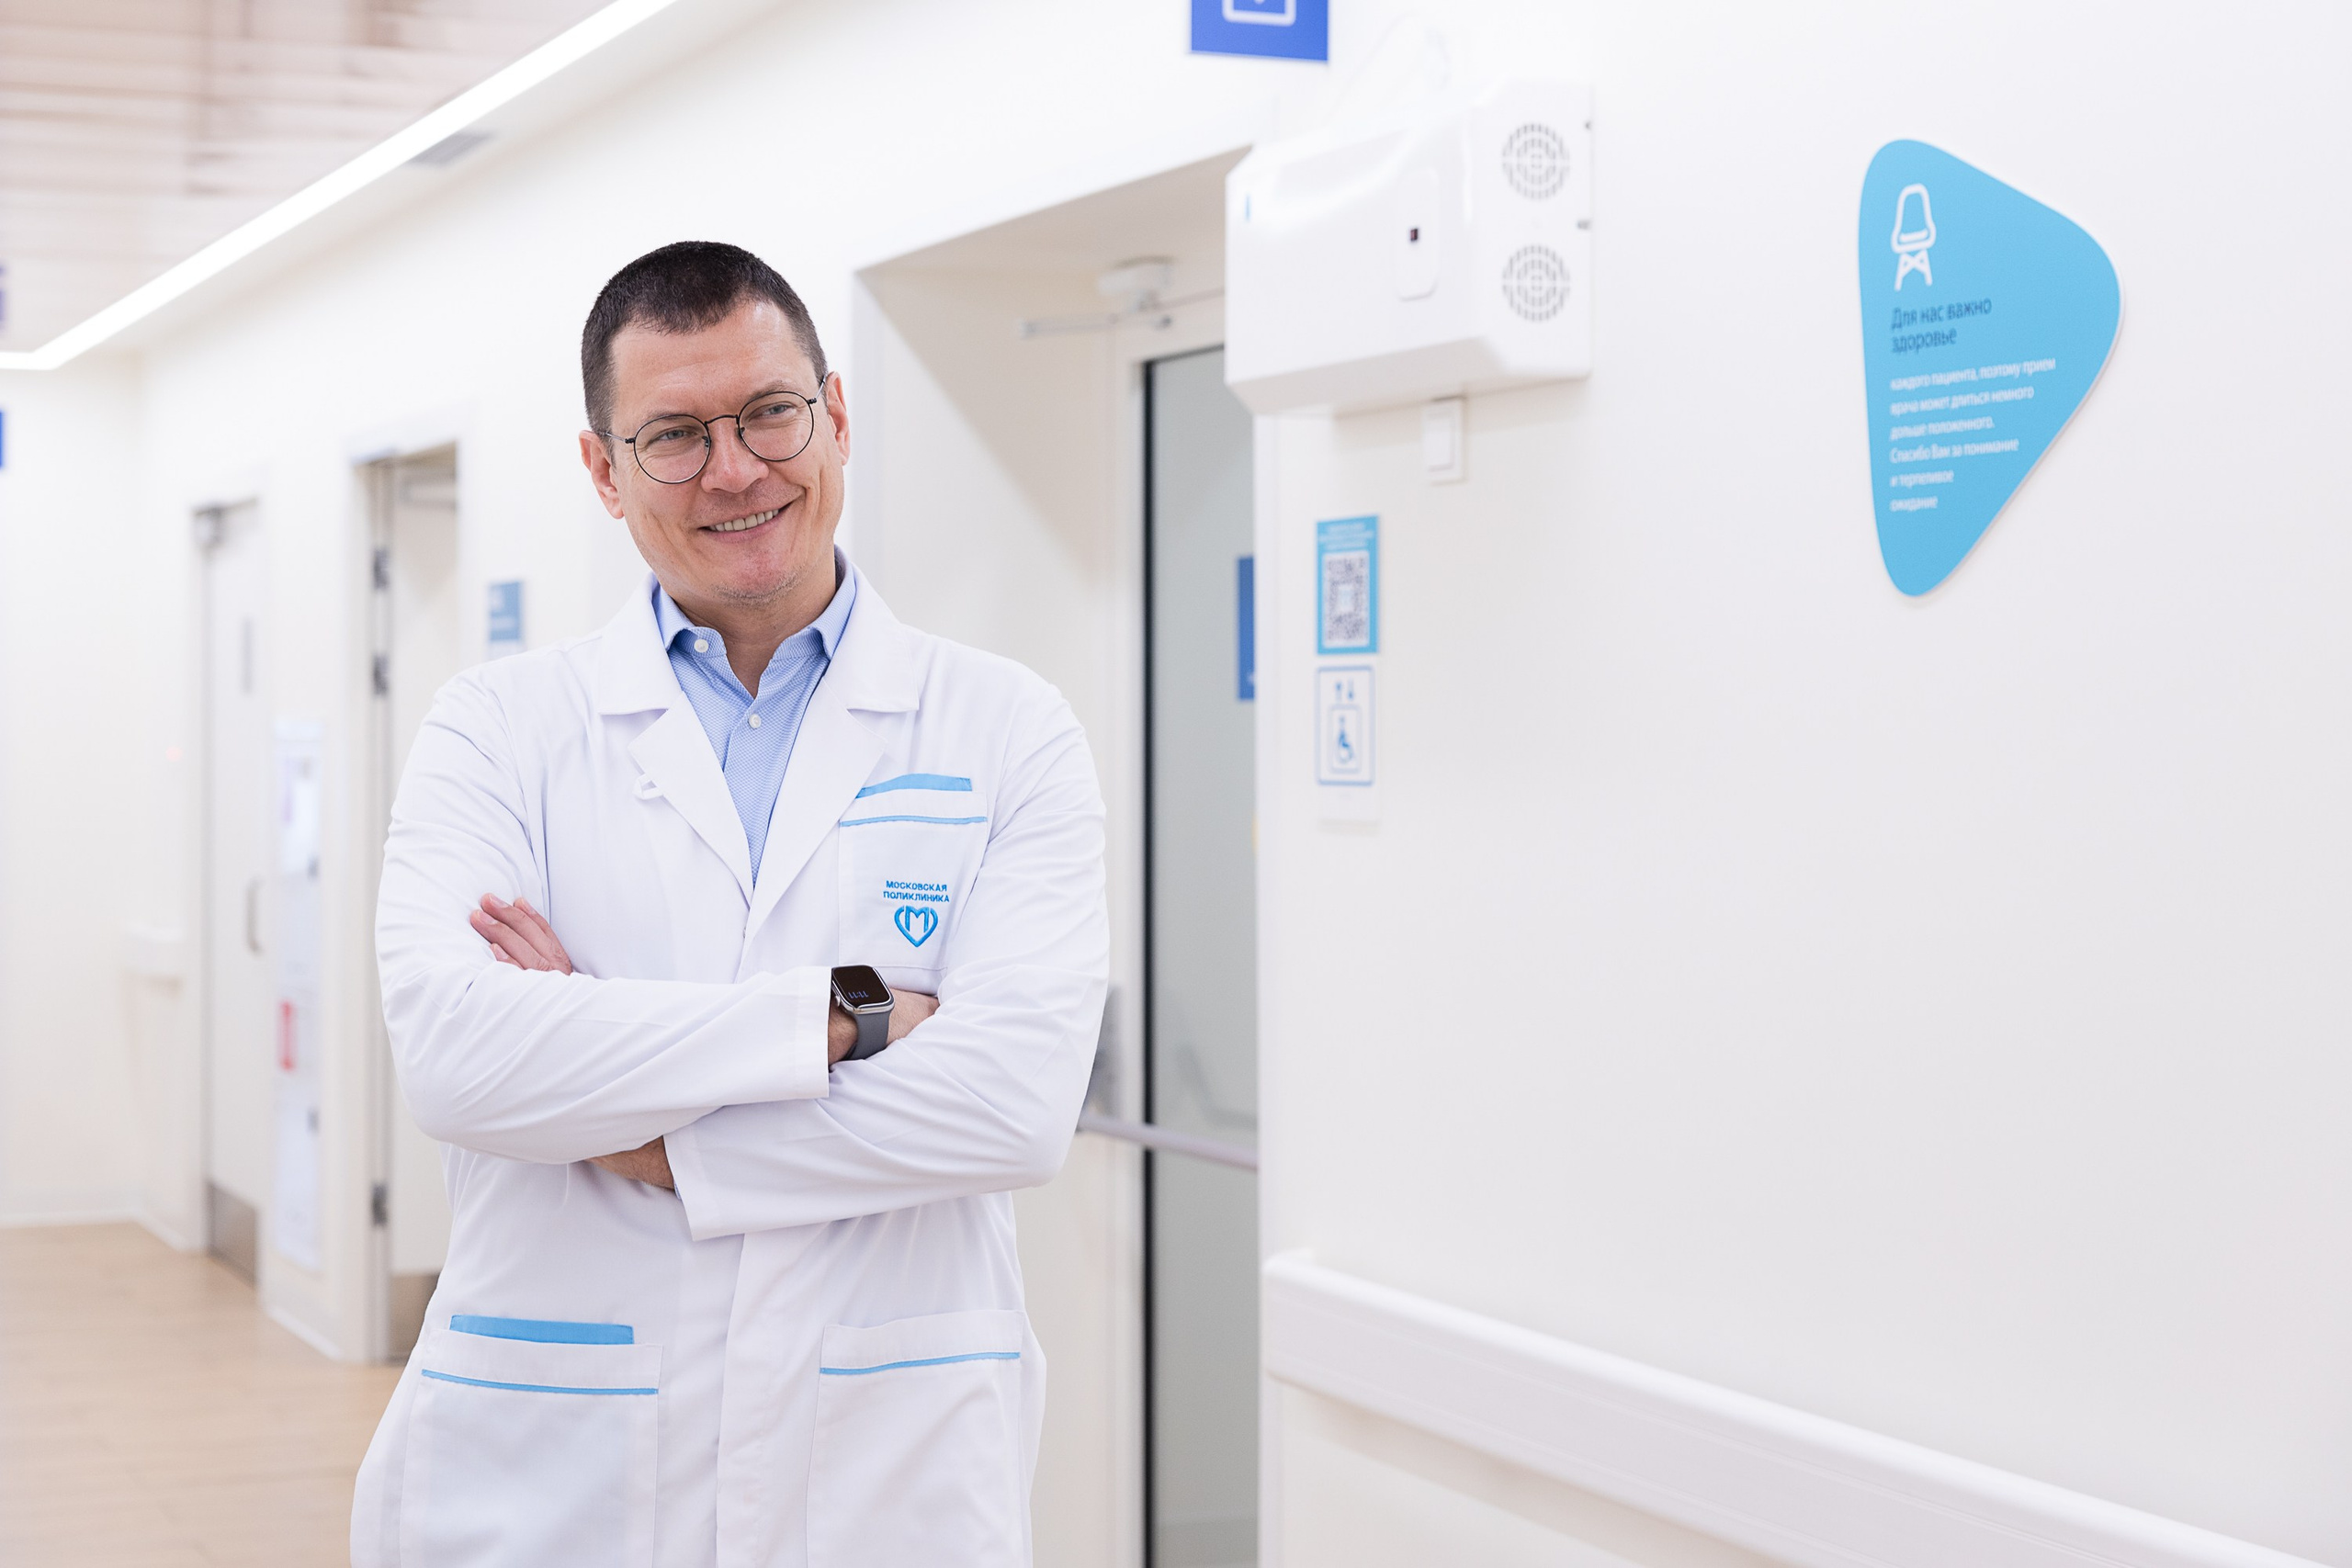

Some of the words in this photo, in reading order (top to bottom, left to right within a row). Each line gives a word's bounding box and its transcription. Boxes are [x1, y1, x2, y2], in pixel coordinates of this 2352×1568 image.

[1891, 307, 1917, 329] Для
[1920, 305, 1944, 323] нас
[1948, 298, 1992, 321] важно
[1891, 328, 1957, 354] здоровье
[1890, 375, 1930, 390] каждого
[1979, 363, 2020, 379] поэтому
[1890, 400, 1919, 416] врача
[1920, 396, 1950, 412] может
[1951, 391, 1990, 409] длиться
[1991, 386, 2035, 402] немного
[1890, 423, 1927, 440] дольше
[1890, 444, 1930, 463] Спасибо
[1952, 444, 1963, 457] за
[1964, 438, 2019, 456] понимание
[1900, 469, 1954, 489] терпеливое
[1889, 496, 1938, 512] ожидание
[883, 890, 949, 902] ПОЛИКЛИНИКА
[886, 880, 947, 892] МОСКОВСКАЯ
